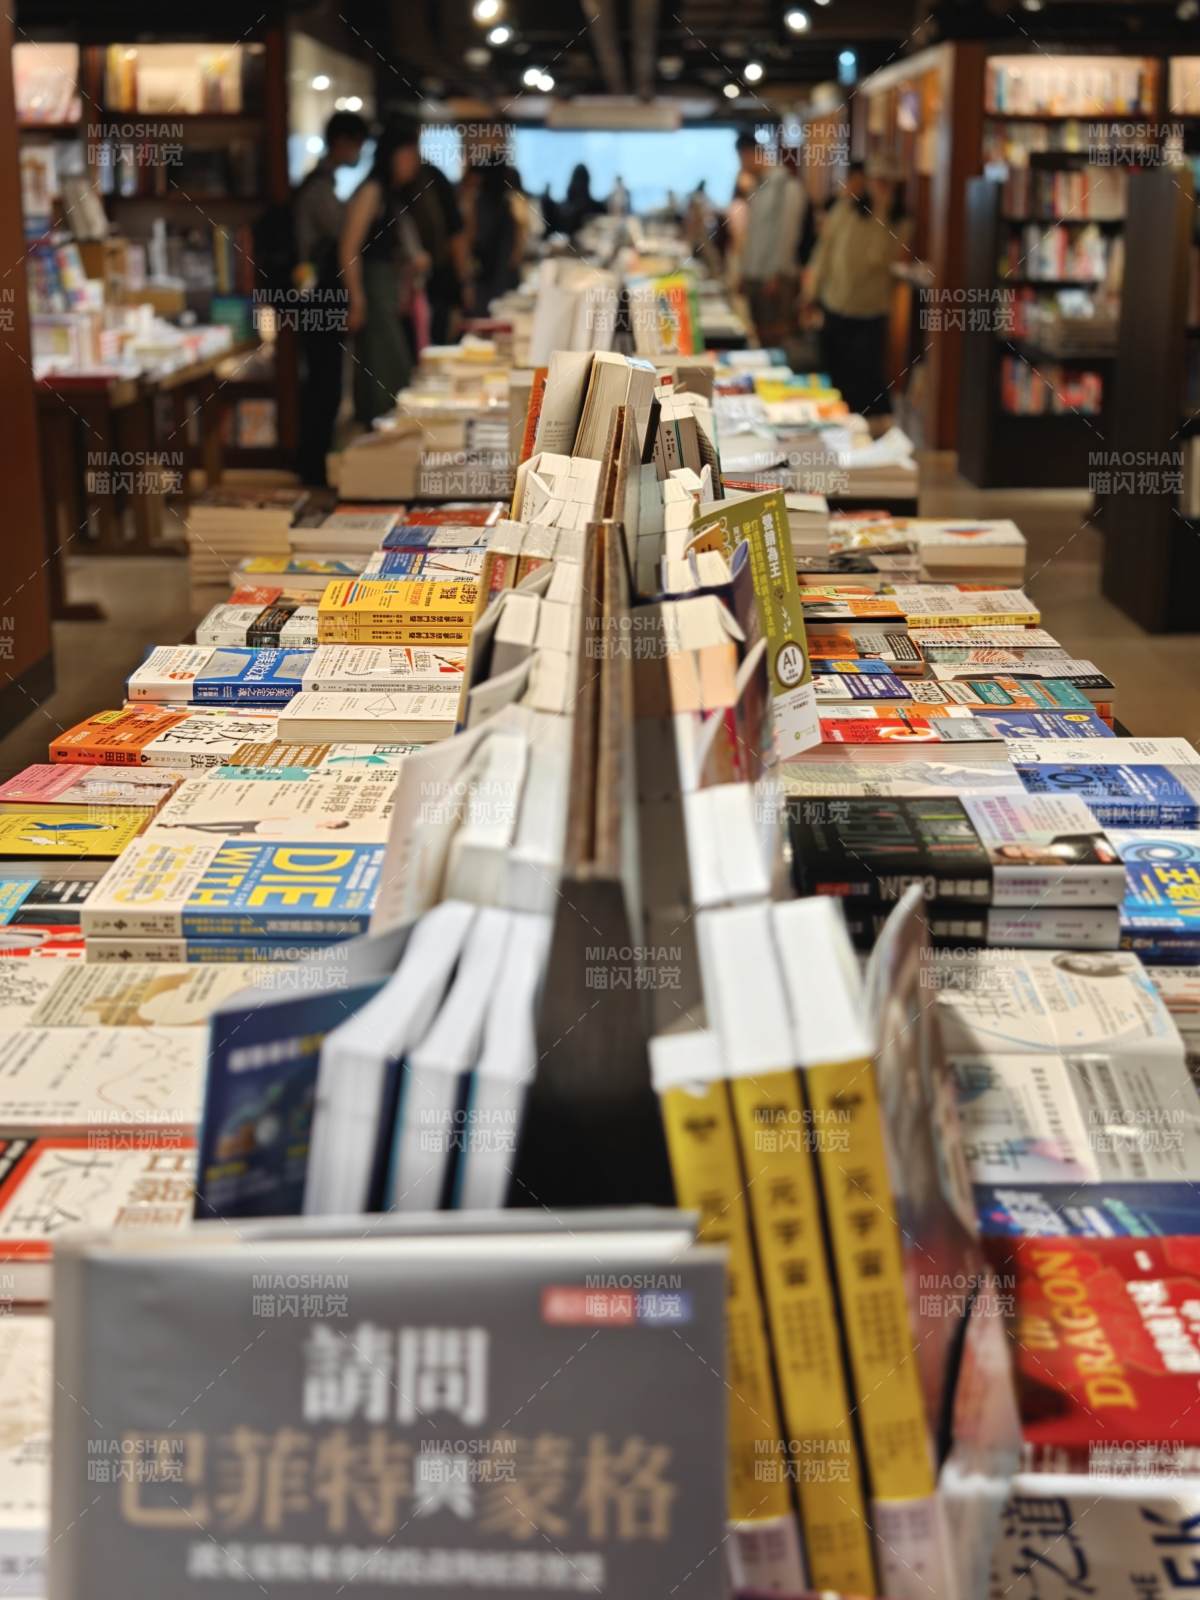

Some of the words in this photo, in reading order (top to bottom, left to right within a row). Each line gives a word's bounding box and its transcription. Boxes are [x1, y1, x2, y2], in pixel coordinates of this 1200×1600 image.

[783, 650, 798, 671] AI
[186, 846, 262, 906] WITH
[246, 848, 356, 908] DIE
[1030, 1250, 1138, 1411] DRAGON
[302, 1323, 489, 1426] 請問
[119, 1427, 678, 1543] 巴菲特與蒙格
